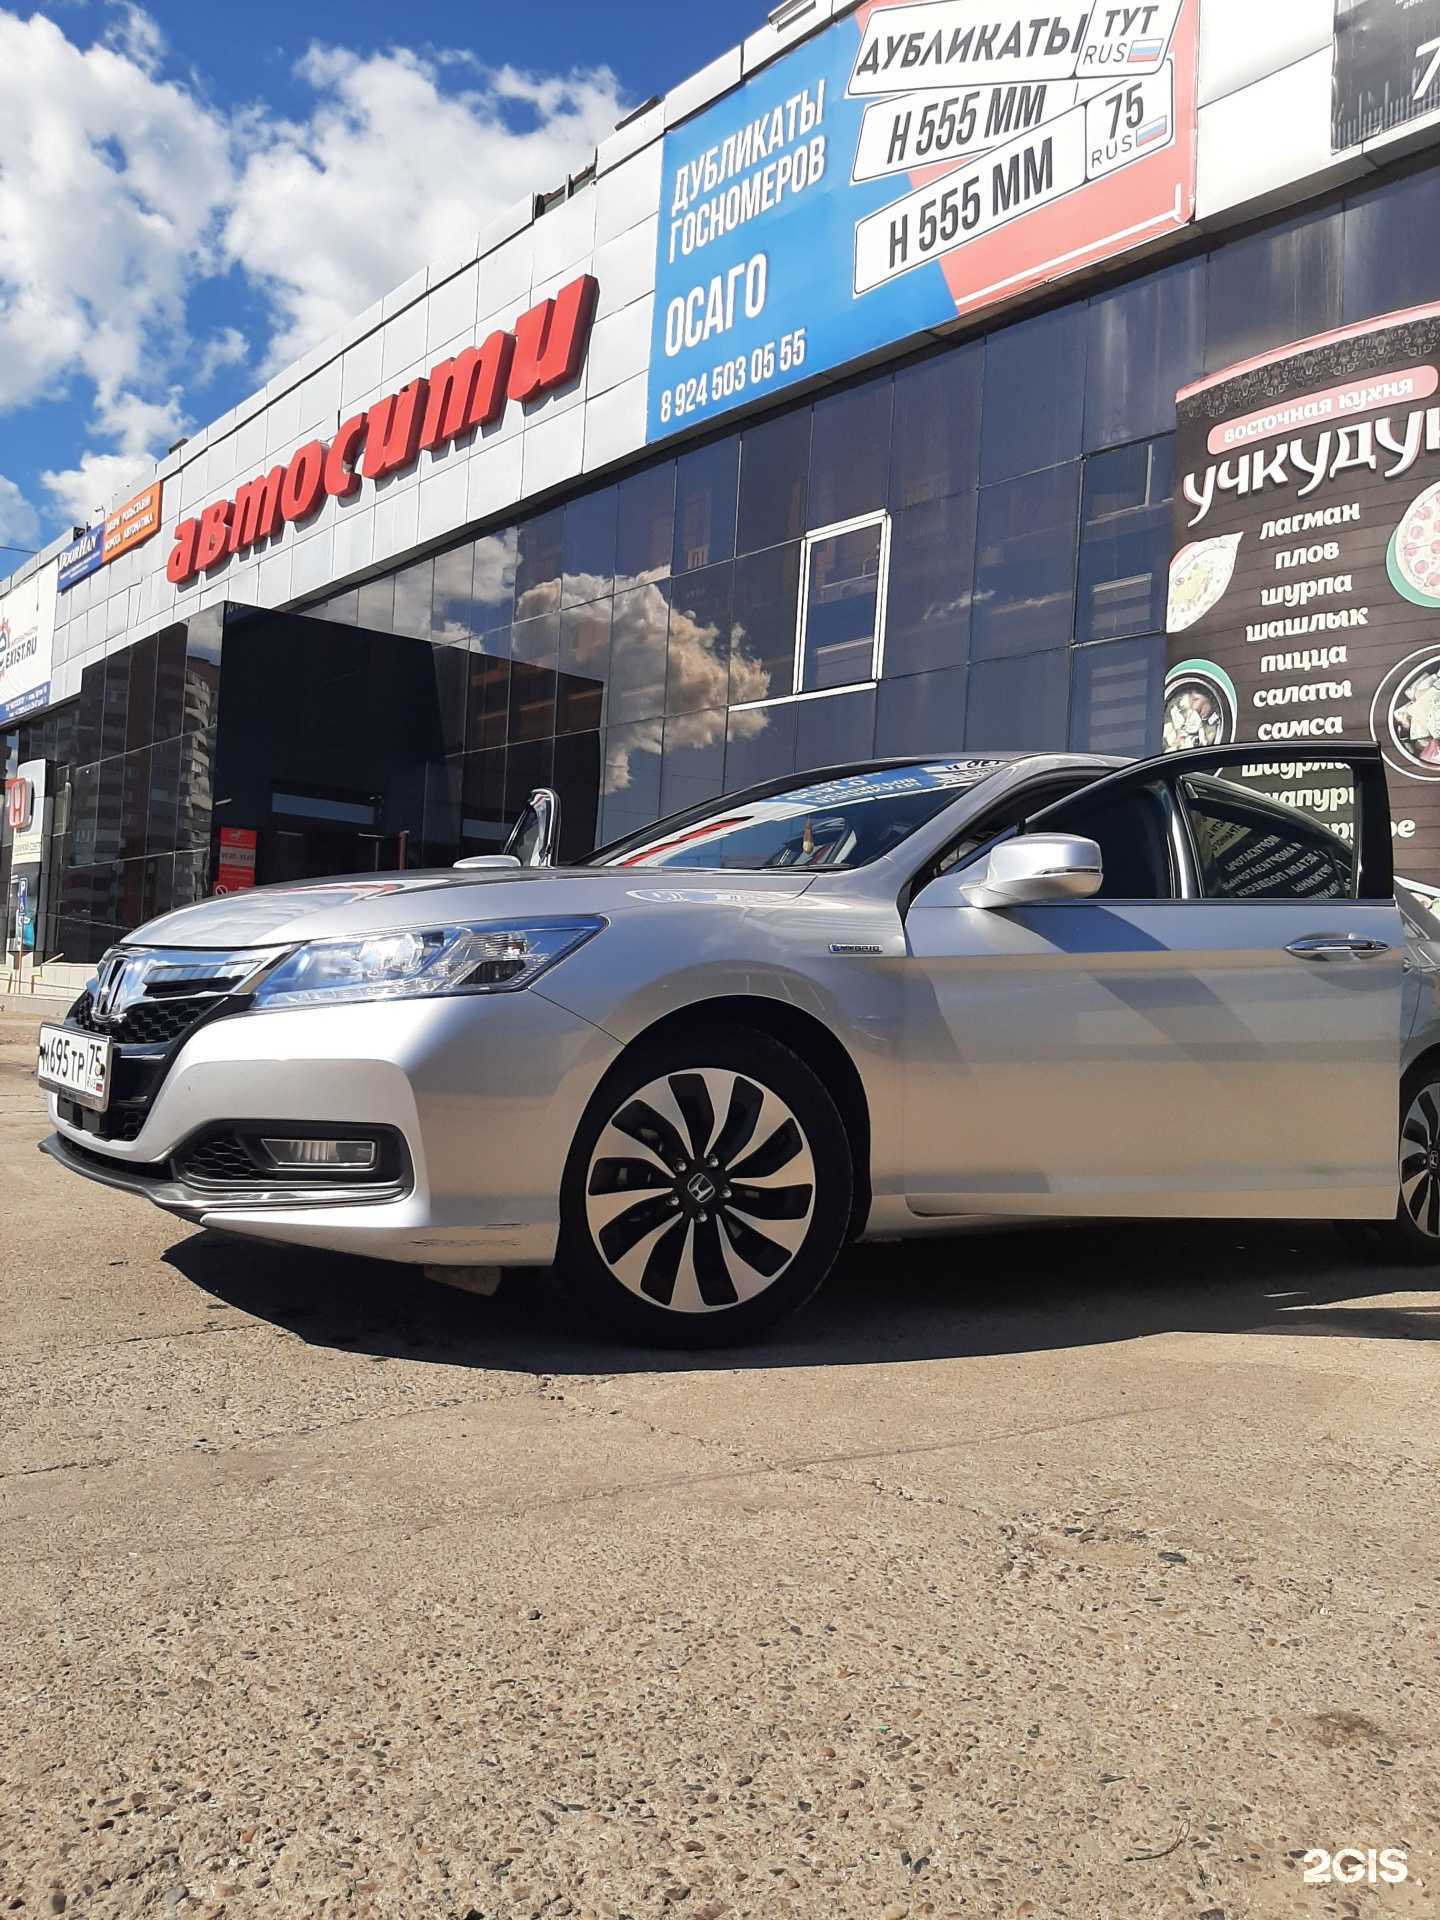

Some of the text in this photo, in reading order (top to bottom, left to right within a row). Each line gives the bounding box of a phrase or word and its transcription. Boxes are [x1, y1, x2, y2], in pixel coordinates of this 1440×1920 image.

[856, 5, 1159, 76] ДУБЛИКАТЫ ТУТ
[1083, 42, 1128, 65] RUS
[887, 84, 1048, 164] Н 555 ММ
[1105, 82, 1144, 139] 75
[671, 79, 826, 217] ДУБЛИКАТЫ
[1091, 135, 1133, 168] RUS
[668, 134, 827, 264] ГОСНОМЕРОВ
[889, 136, 1053, 269] Н 555 ММ
[664, 252, 768, 358] ОСАГО
[661, 328, 806, 423] 8 924 503 05 55
[1223, 377, 1414, 443] восточная кухня
[1259, 502, 1361, 540] лагман
[1275, 541, 1340, 570] плов
[1260, 574, 1353, 608] шурпа
[1246, 607, 1368, 642] шашлык
[5, 635, 38, 670] EXIST.RU
[1260, 645, 1347, 673] пицца
[1253, 679, 1352, 708] салаты
[1257, 715, 1343, 741] самса
[89, 1043, 104, 1077] 75
